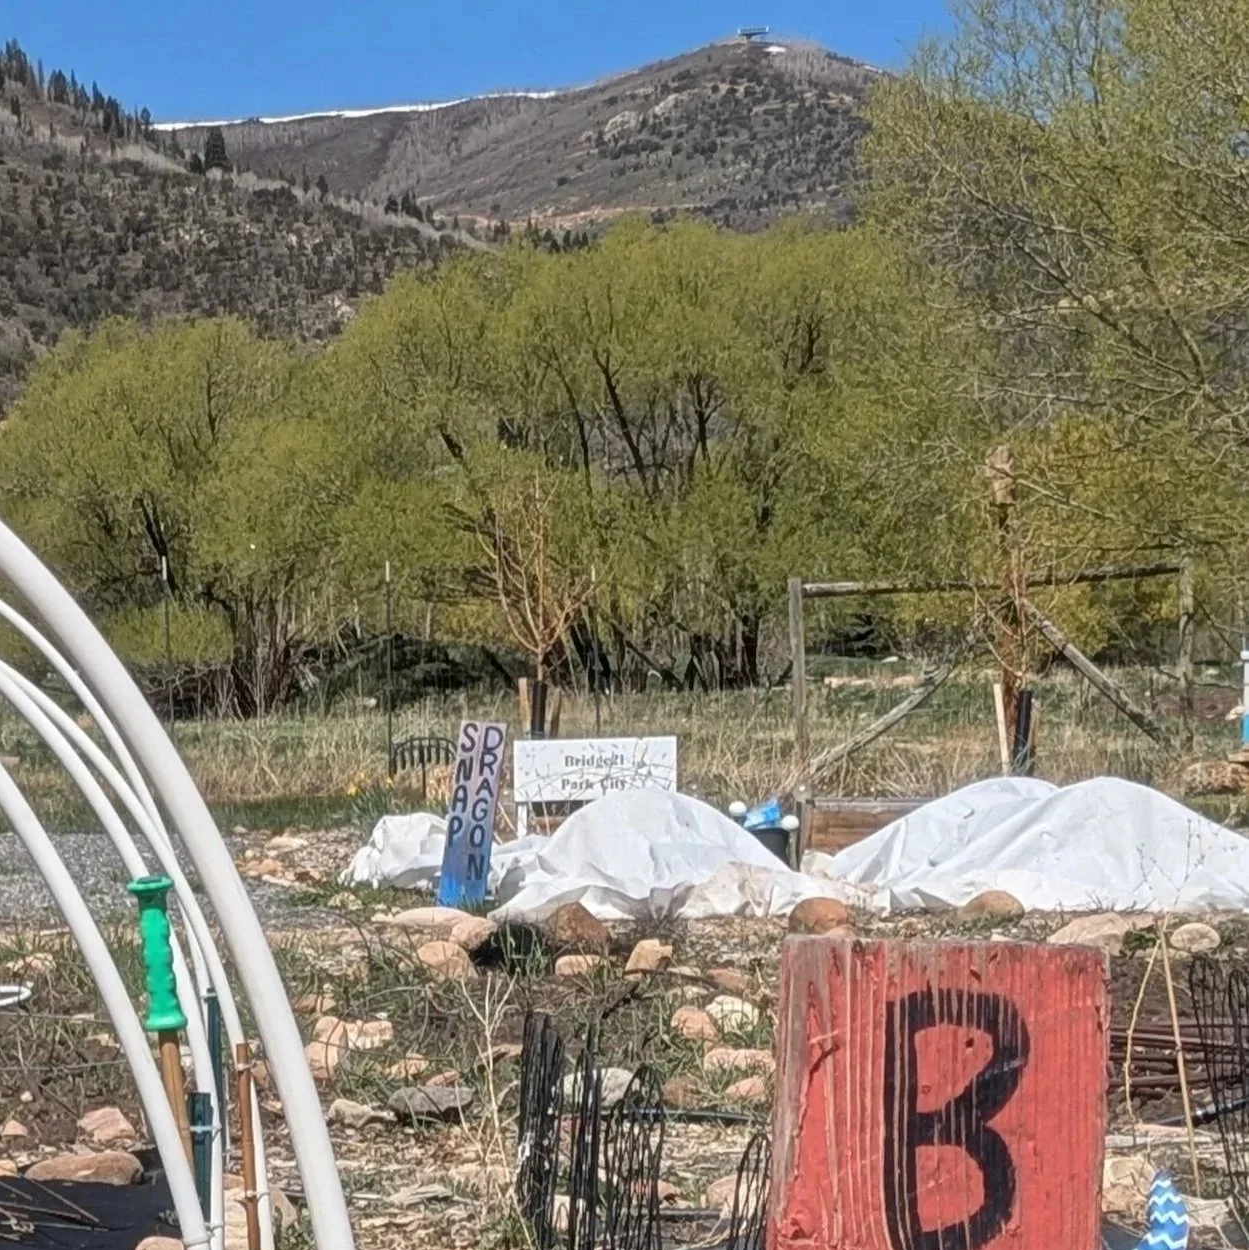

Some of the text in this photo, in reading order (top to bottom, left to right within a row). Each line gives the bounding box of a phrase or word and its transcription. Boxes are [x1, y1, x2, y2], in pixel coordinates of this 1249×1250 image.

[449, 723, 478, 848] SNAP
[466, 726, 503, 880] DRAGON
[561, 778, 627, 791] Park City
